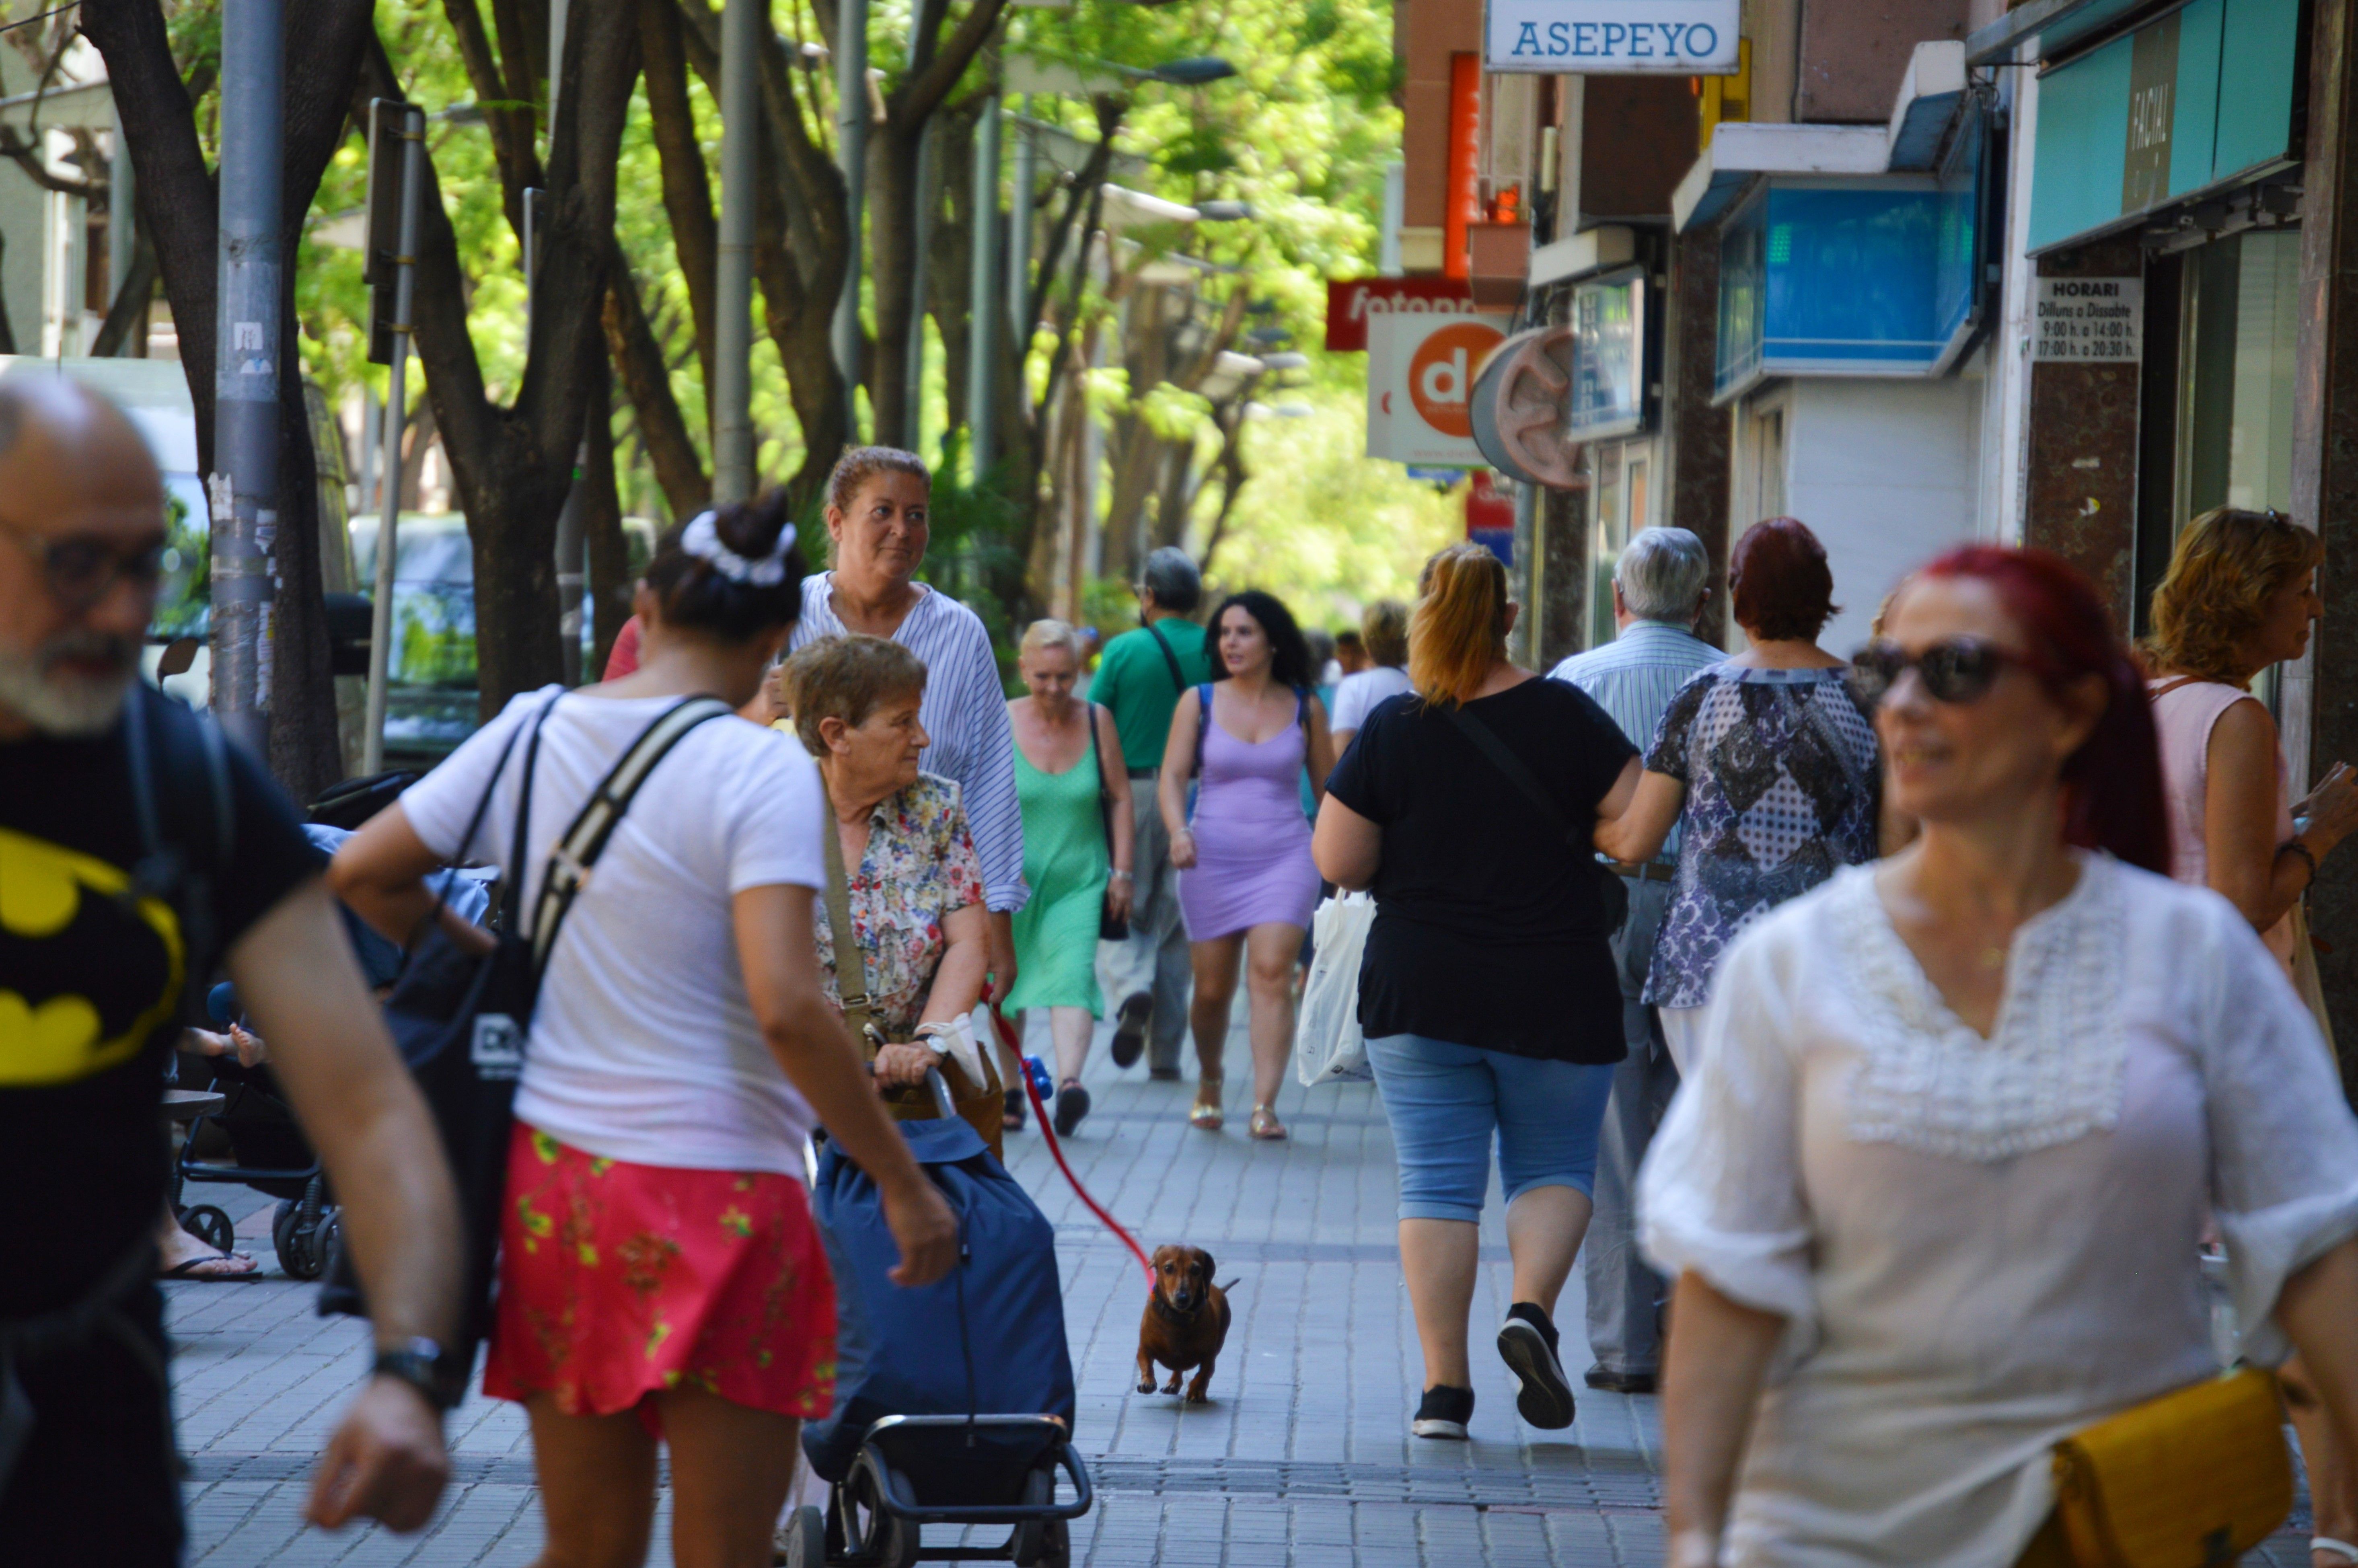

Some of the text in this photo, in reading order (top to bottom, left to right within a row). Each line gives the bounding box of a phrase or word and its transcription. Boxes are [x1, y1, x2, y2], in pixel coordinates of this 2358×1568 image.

[1511, 21, 1717, 57] ASEPEYO
[2132, 83, 2168, 150] FACIAL
[2054, 283, 2119, 296] HORARI
[2038, 302, 2131, 317] Dilluns a Dissabte
[2044, 321, 2066, 337] 9:00
[2083, 326, 2089, 337] a
[2094, 321, 2122, 337] 14:00
[2039, 341, 2066, 356] 17:00
[2083, 345, 2089, 356] a
[2093, 341, 2122, 356] 20:30
[1423, 347, 1467, 403] d
